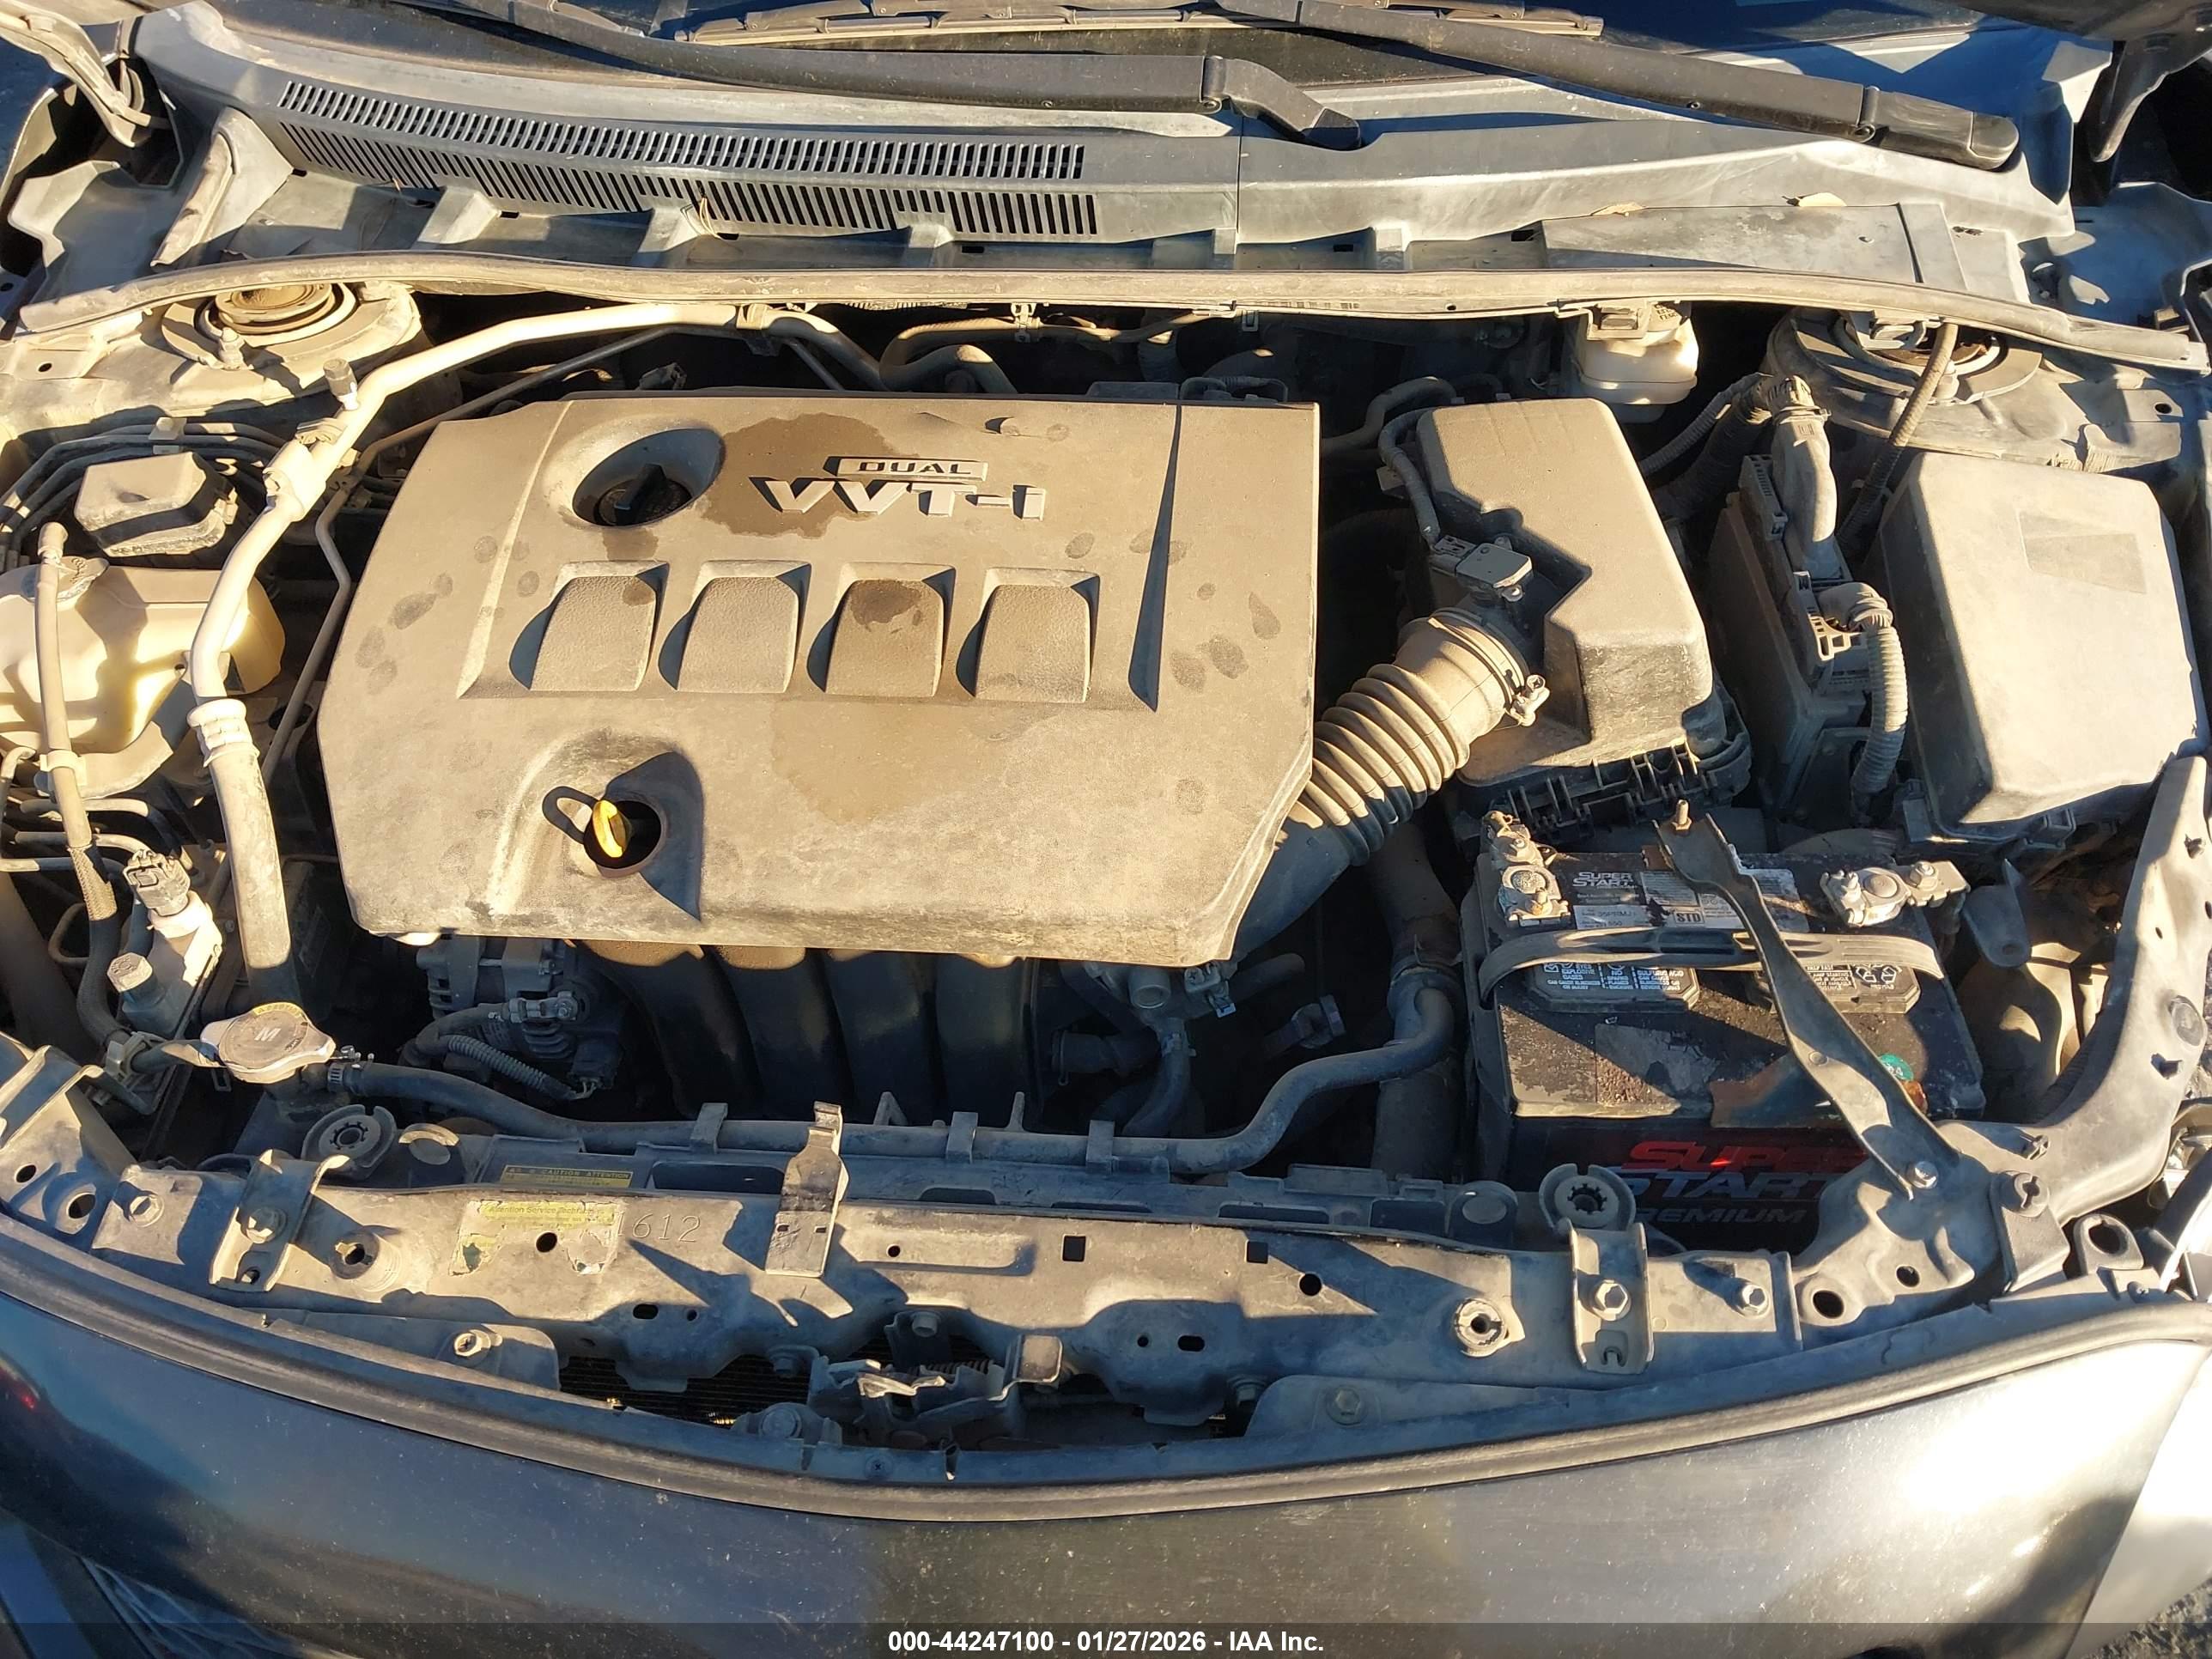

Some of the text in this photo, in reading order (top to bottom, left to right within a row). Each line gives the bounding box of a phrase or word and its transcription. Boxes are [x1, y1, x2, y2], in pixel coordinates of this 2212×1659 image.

[859, 460, 972, 475] DUAL
[1572, 878, 1628, 887] START
[1676, 912, 1702, 923] STD
[586, 1170, 629, 1179] ATTENTION
[488, 1206, 526, 1214] Attention
[526, 1206, 557, 1215] Service
[1636, 1208, 1808, 1223] REMIUM
